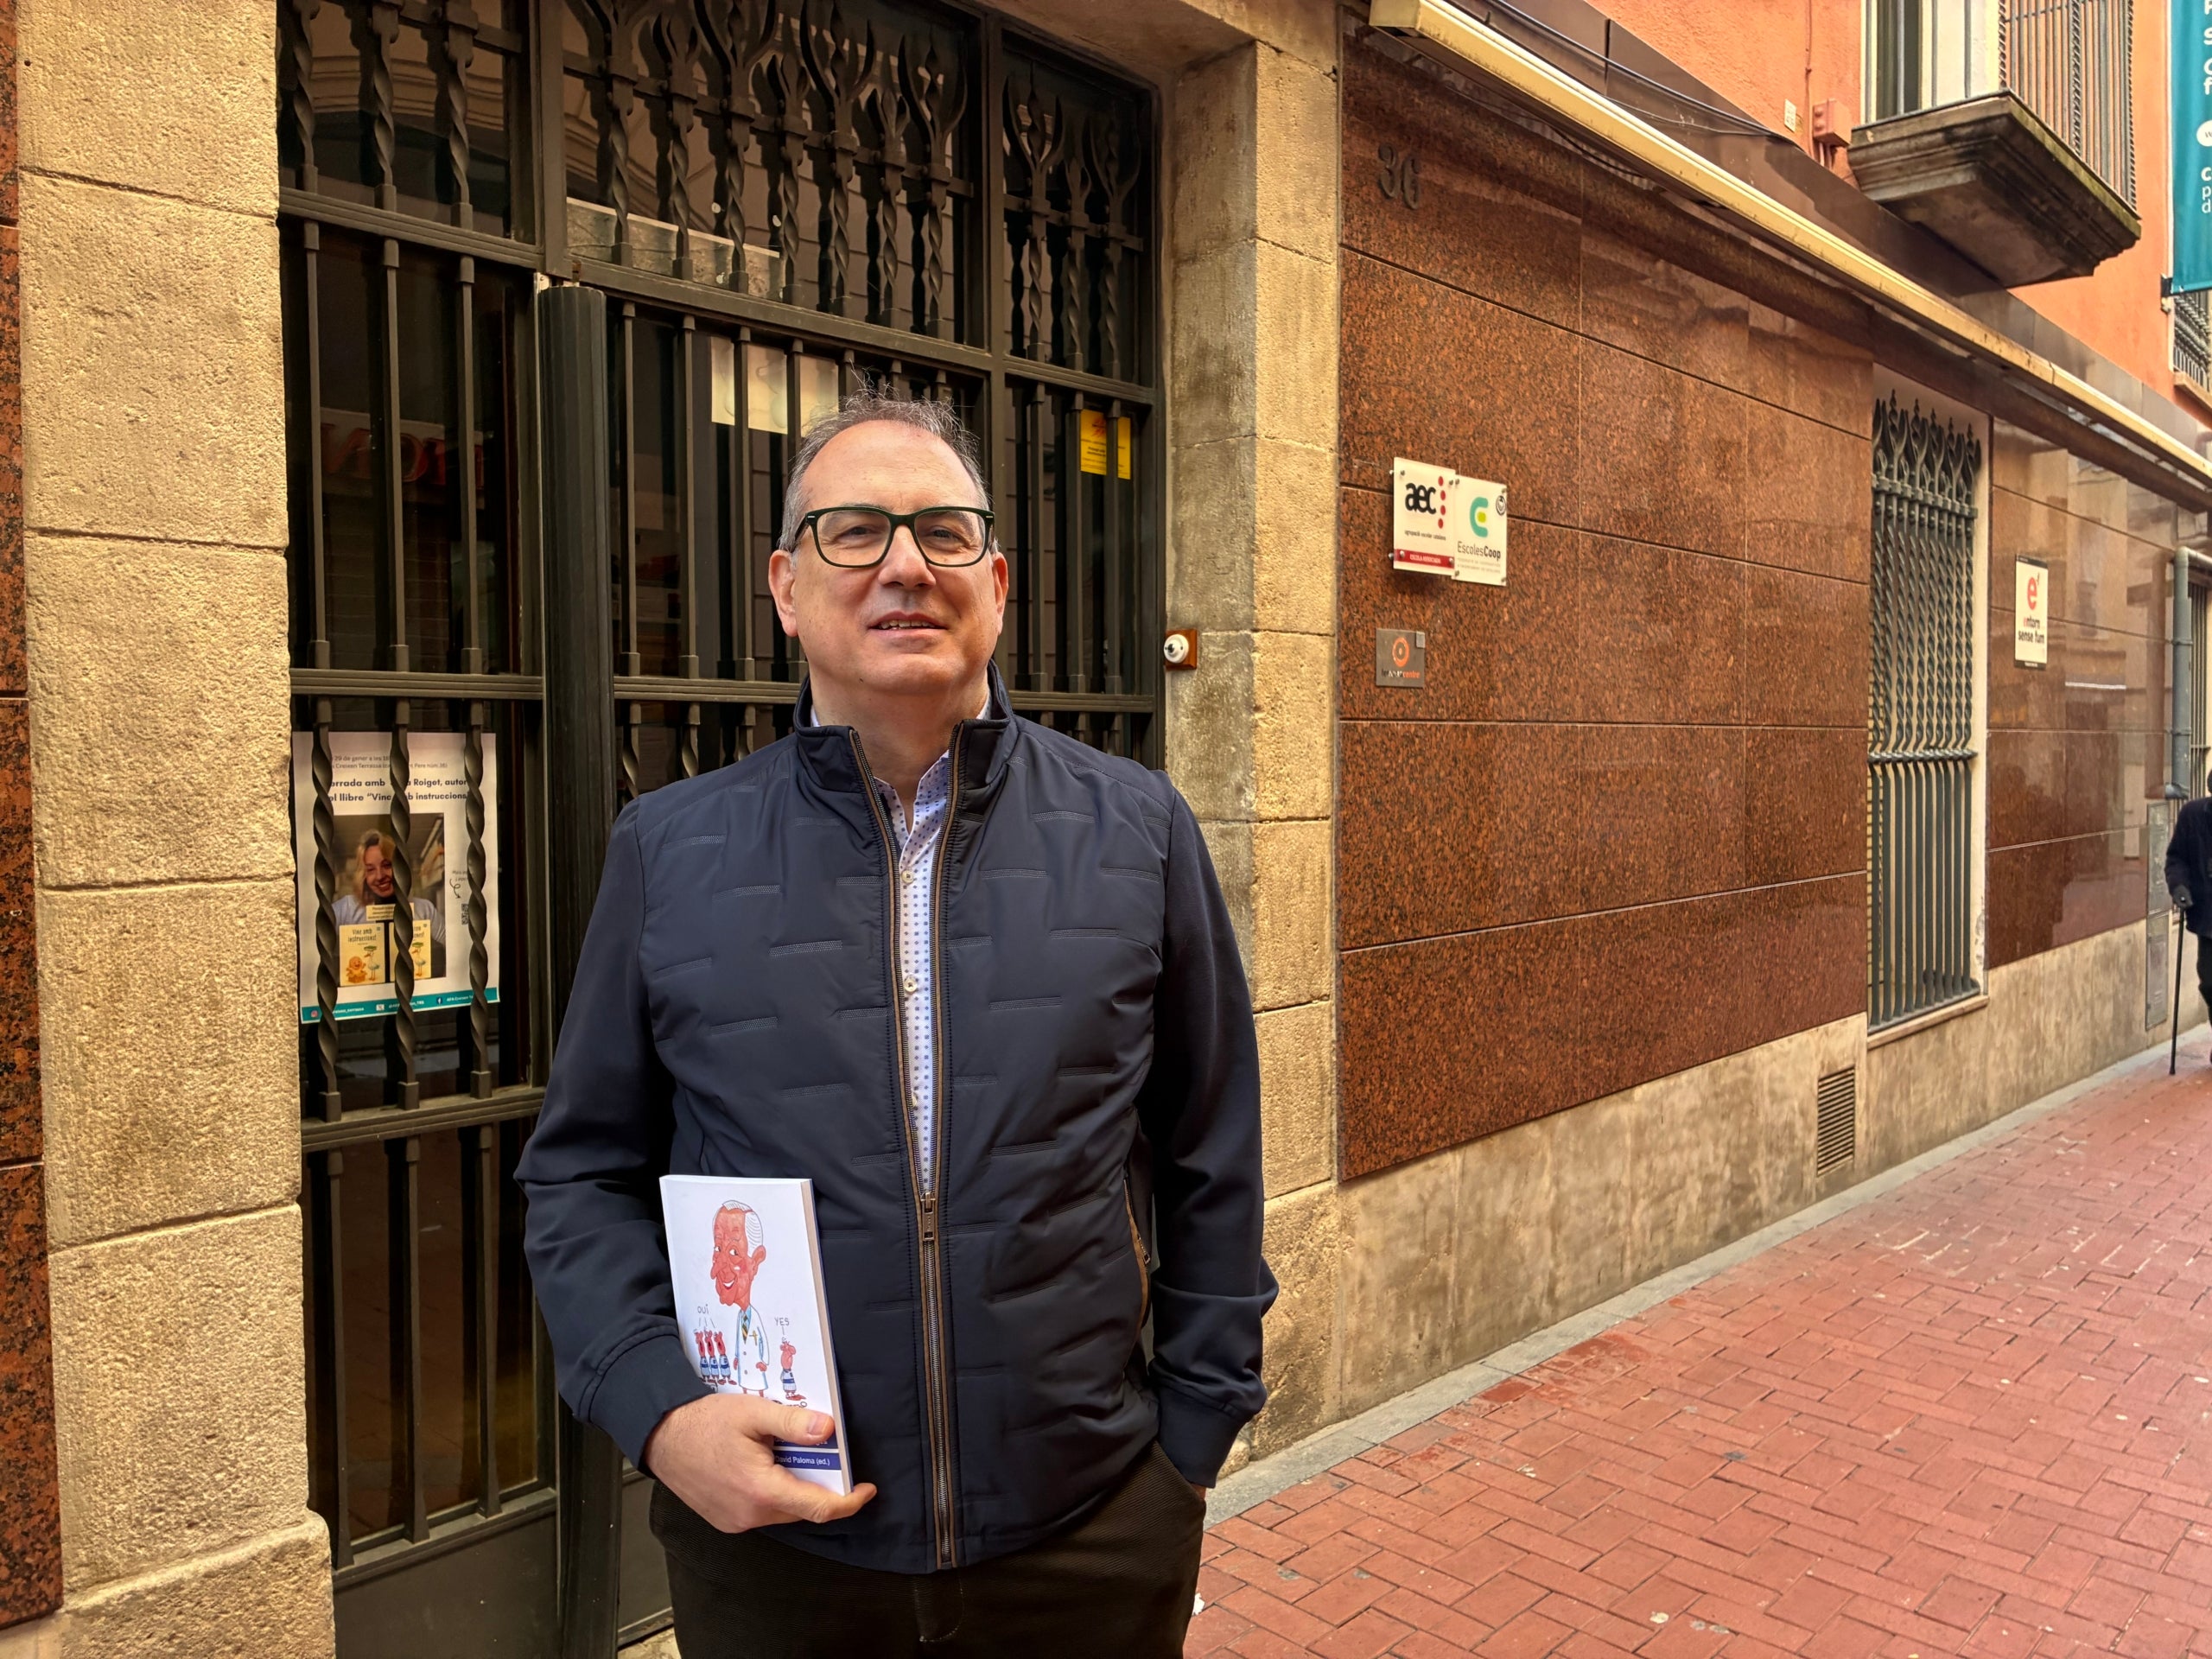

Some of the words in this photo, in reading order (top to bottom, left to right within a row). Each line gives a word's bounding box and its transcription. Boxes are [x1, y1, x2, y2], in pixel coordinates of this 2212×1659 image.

[1404, 481, 1436, 515] aec
[1457, 541, 1501, 562] EscolesCoop
[2018, 631, 2033, 643] sense
[365, 778, 385, 786] amb
[416, 791, 467, 800] instruccions
[774, 1317, 790, 1326] YES
[775, 1455, 791, 1464] David
[792, 1456, 815, 1465] Paloma
[816, 1458, 830, 1466] (ed.)
